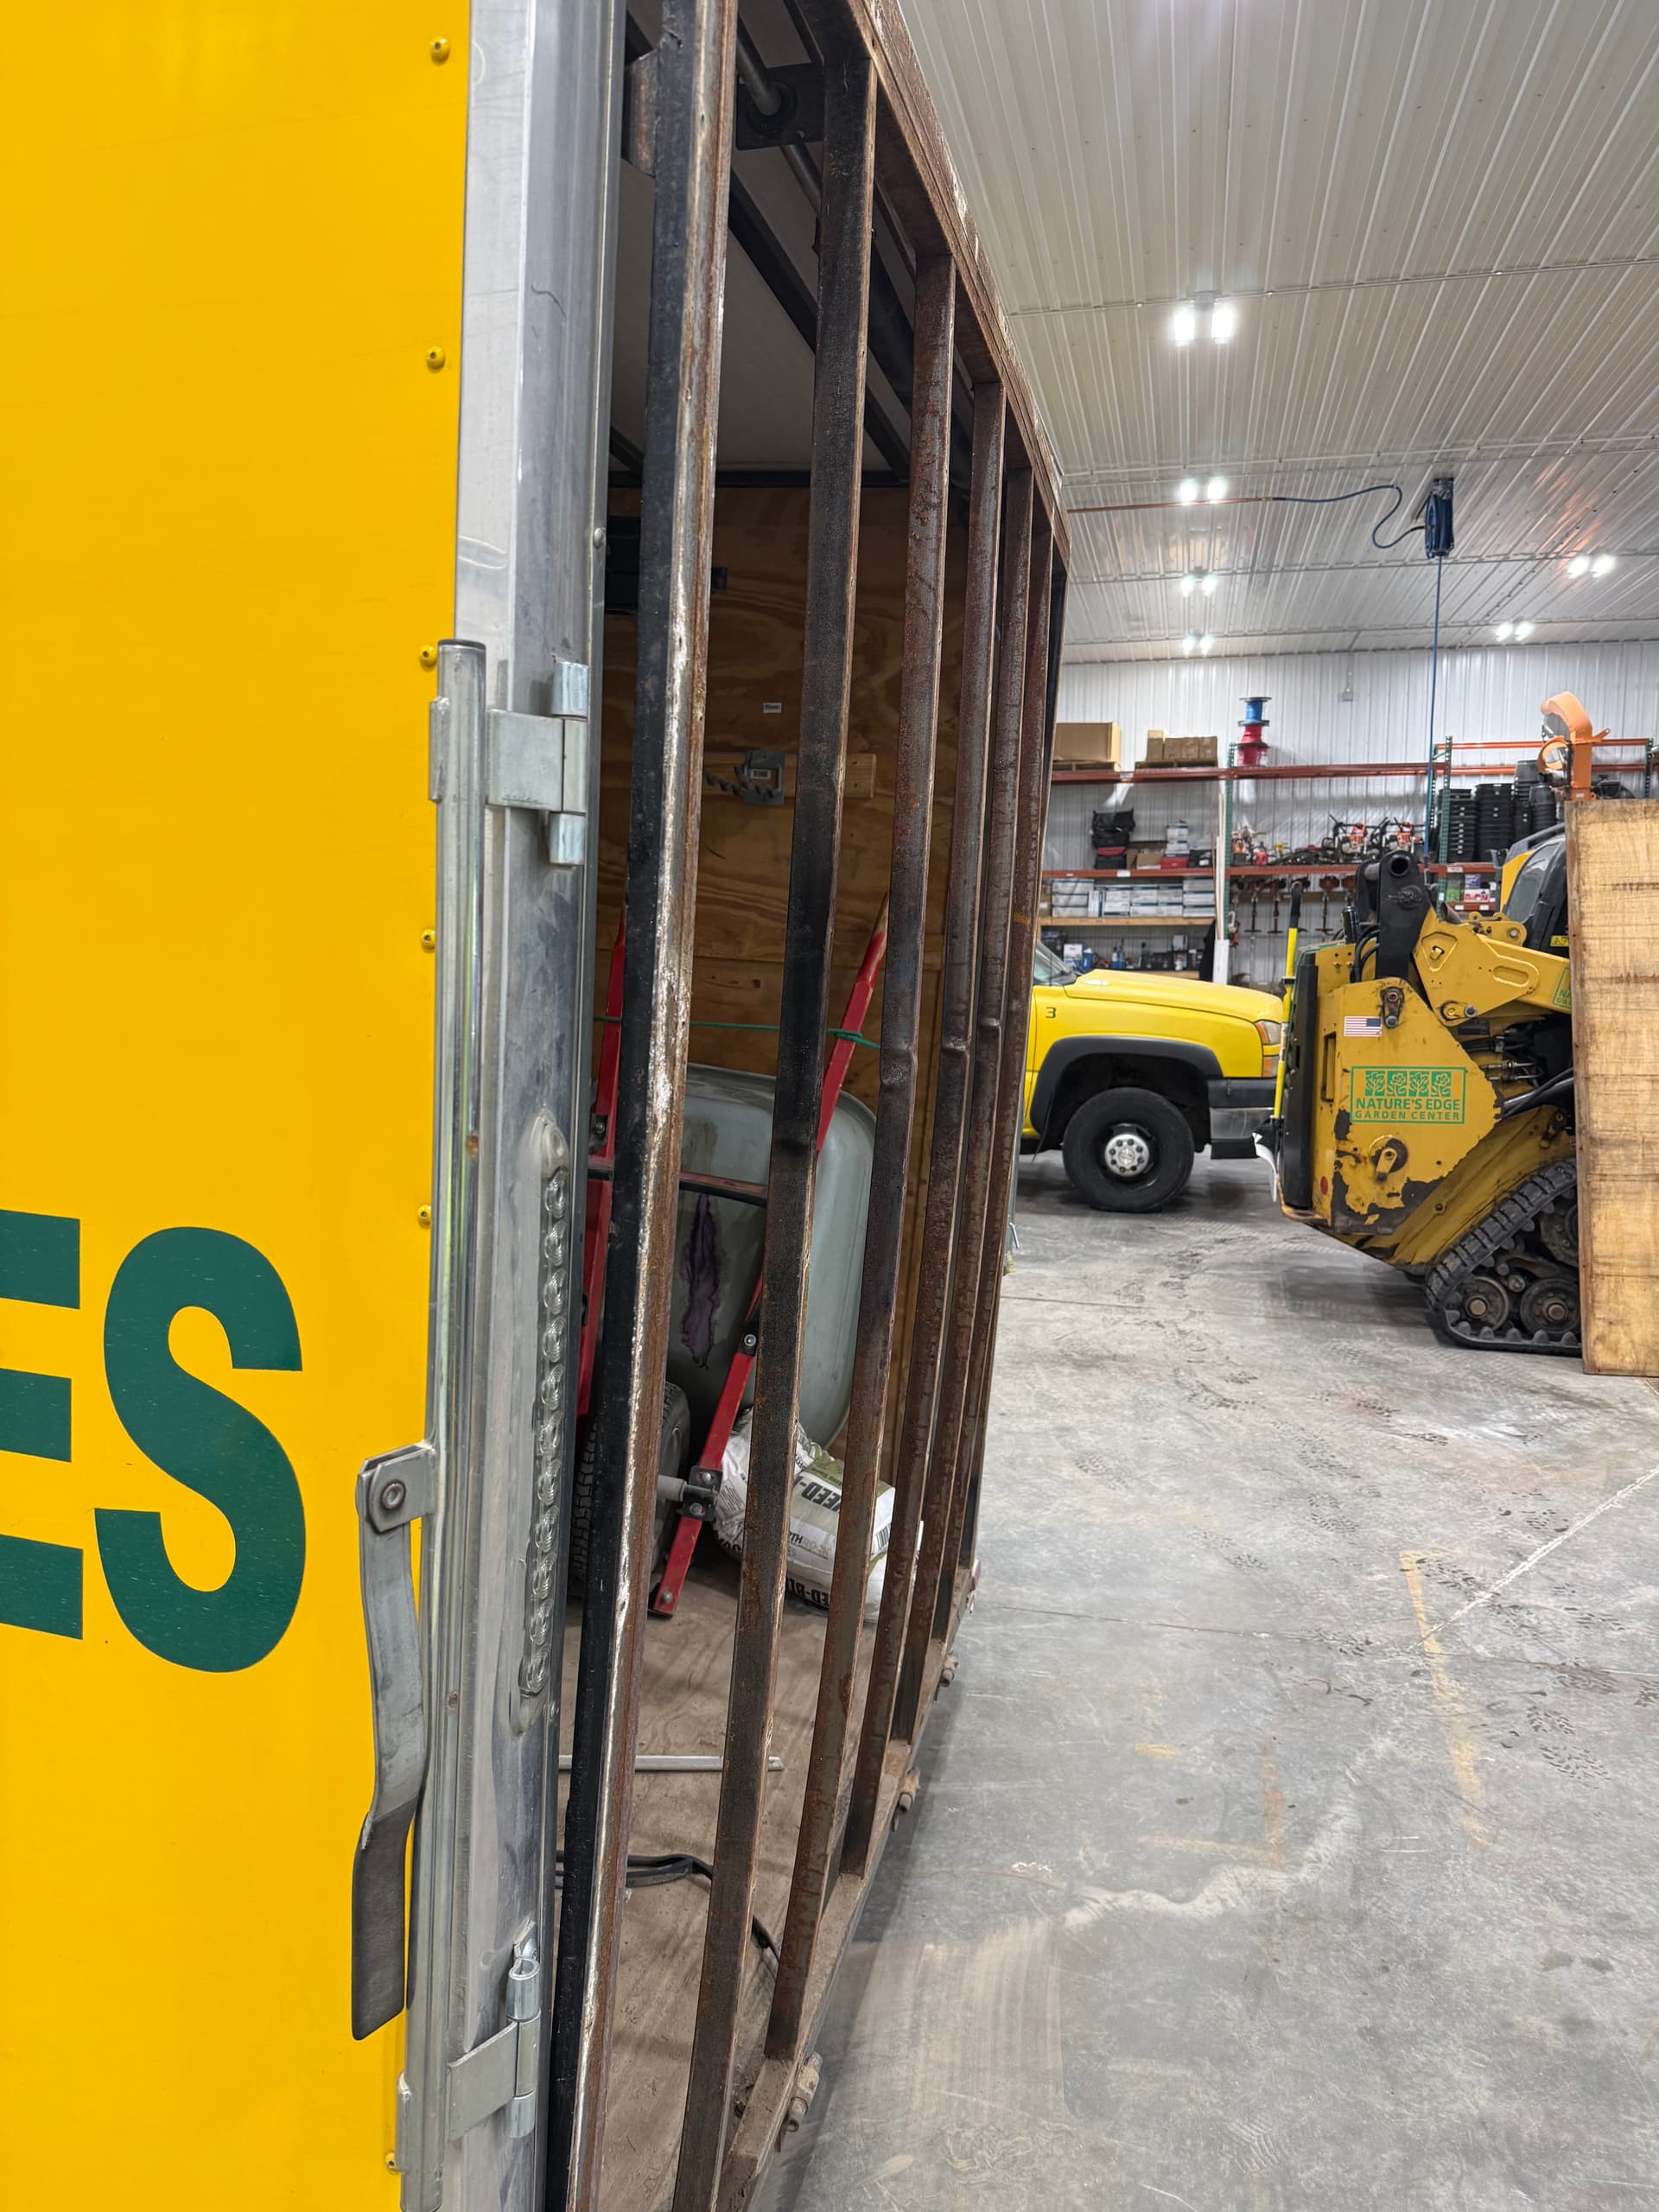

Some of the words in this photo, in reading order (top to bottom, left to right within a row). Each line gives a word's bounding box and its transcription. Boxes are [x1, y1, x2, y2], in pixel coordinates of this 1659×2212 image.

[1045, 1007, 1056, 1019] 3
[1356, 1097, 1422, 1110] NATURE'S
[1426, 1098, 1459, 1110] EDGE
[1355, 1110, 1406, 1120] GARDEN
[1411, 1111, 1459, 1121] CENTER
[793, 1475, 841, 1513] EED-
